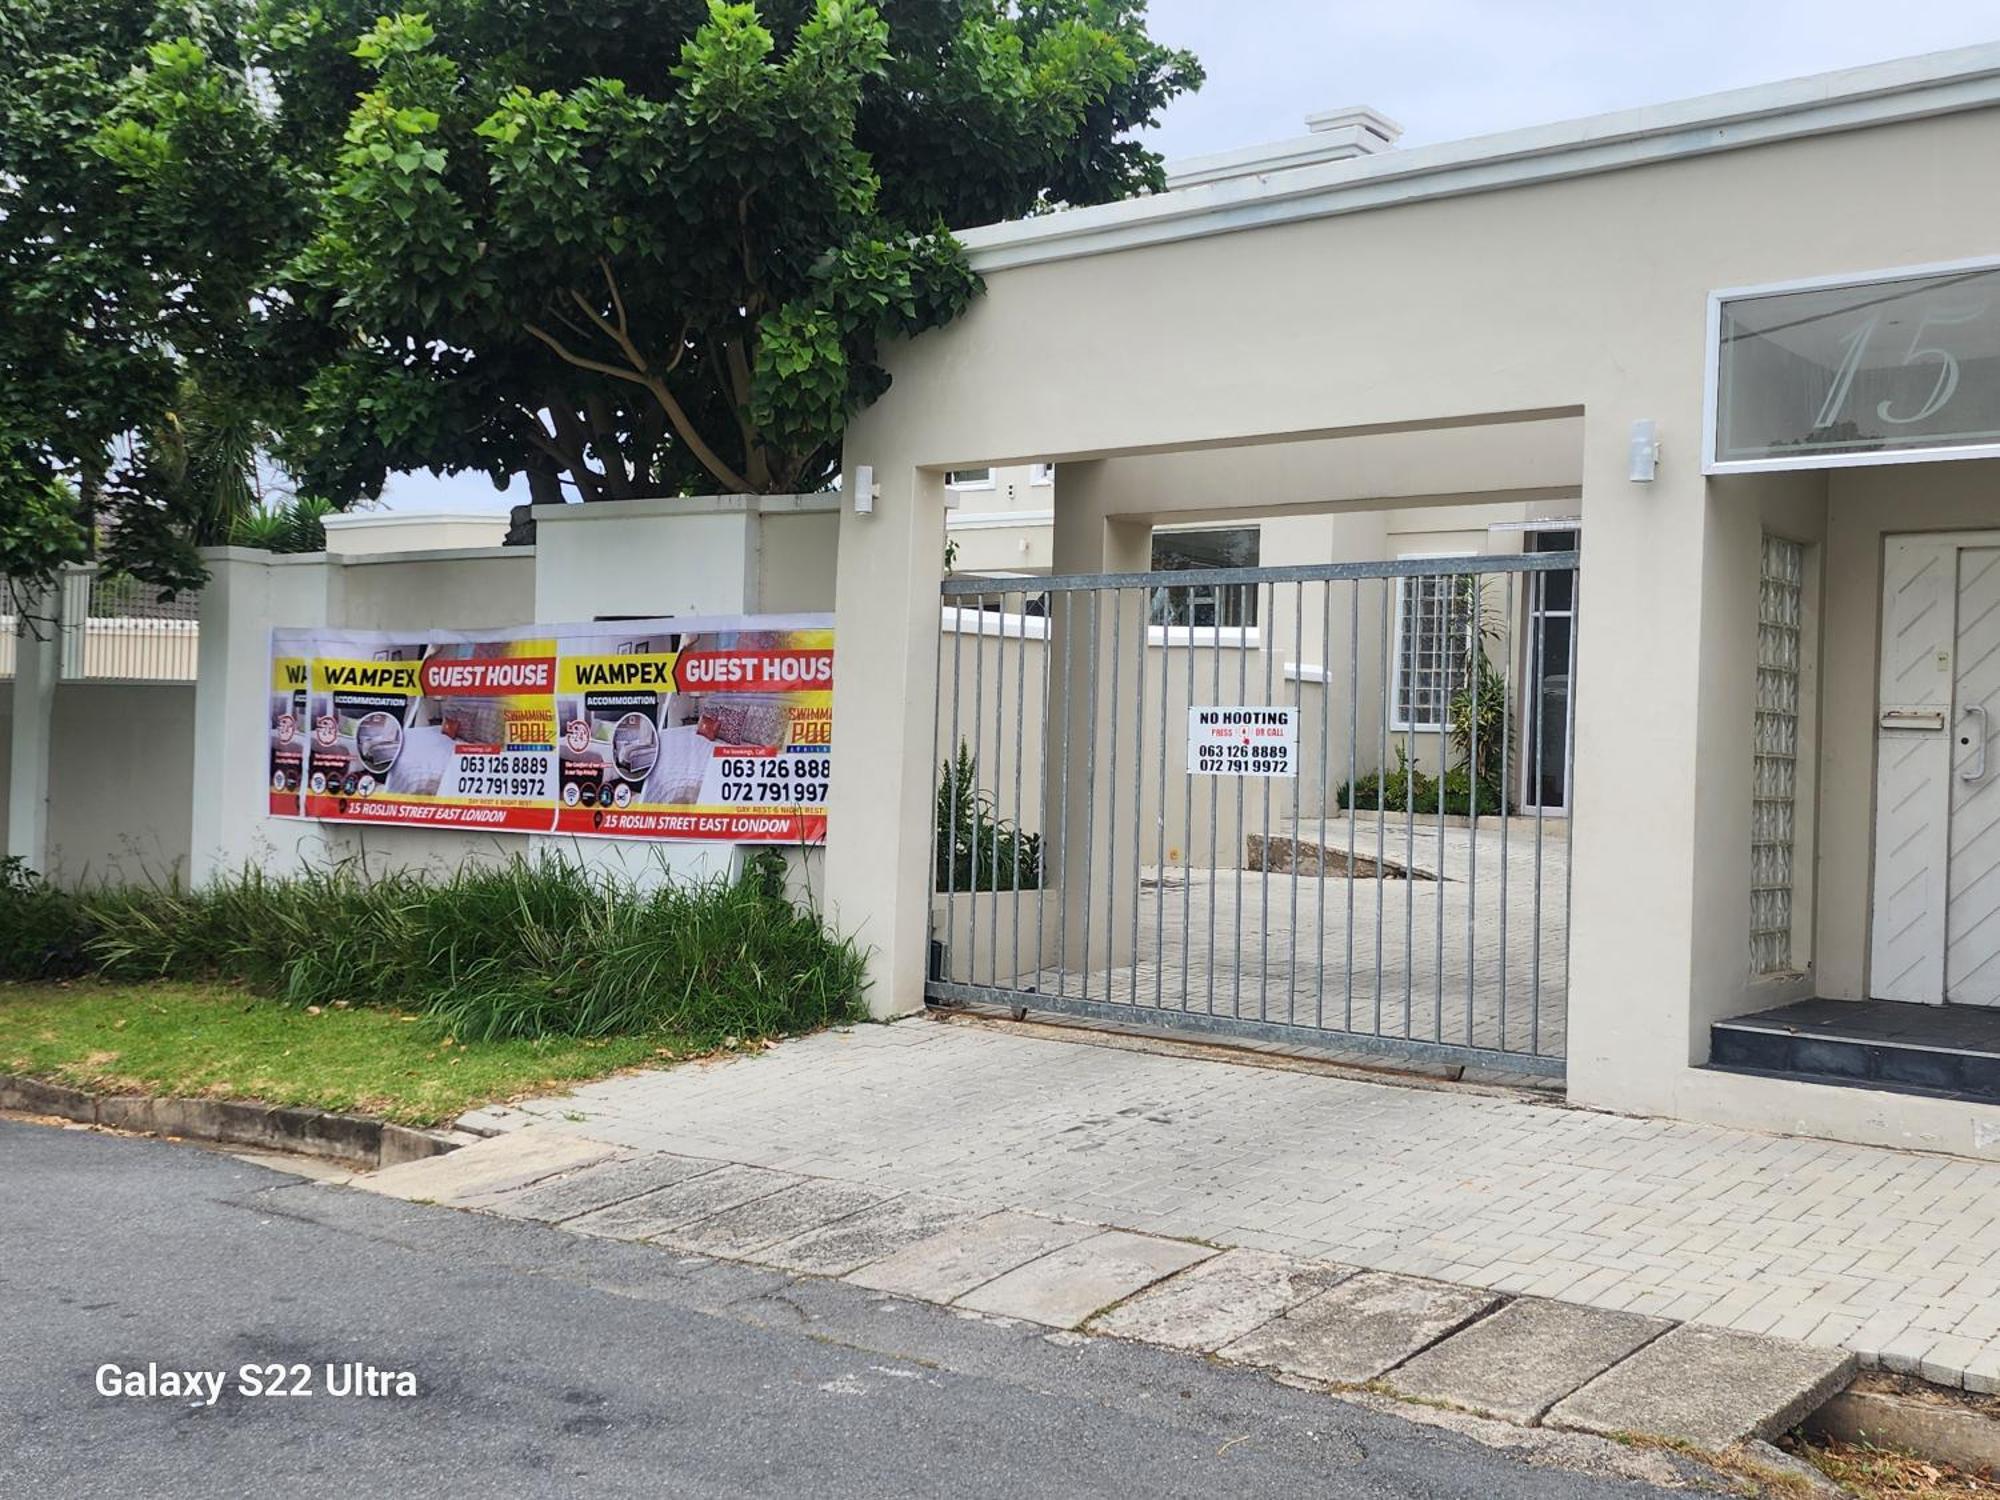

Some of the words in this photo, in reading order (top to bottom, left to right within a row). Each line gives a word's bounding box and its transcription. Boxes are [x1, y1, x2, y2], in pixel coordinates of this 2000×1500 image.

[1815, 297, 1990, 428] 15
[324, 666, 416, 688] WAMPEX
[428, 667, 484, 687] GUEST
[485, 664, 548, 686] HOUSE
[576, 662, 667, 685] WAMPEX
[686, 658, 757, 682] GUEST
[587, 695, 656, 706] ACCOMMODATION
[504, 709, 552, 721] SWIMMING
[1200, 712, 1219, 724] NO
[1223, 712, 1288, 725] HOOTING
[510, 723, 552, 743] POOL
[1212, 728, 1232, 736] PRESS
[1255, 728, 1265, 736] OR
[1267, 728, 1284, 737] CALL
[1199, 745, 1223, 757] 063
[1227, 745, 1248, 758] 126
[1251, 746, 1287, 758] 8889
[460, 756, 485, 774] 063
[488, 757, 509, 774] 126
[511, 757, 548, 775] 8889
[722, 759, 755, 778] 063
[760, 759, 789, 778] 126
[1200, 759, 1223, 771] 072
[1227, 760, 1248, 772] 791
[1252, 760, 1288, 772] 9972
[458, 777, 483, 794] 072
[486, 778, 508, 795] 791
[511, 778, 545, 796] 9972
[721, 782, 753, 801] 072
[757, 783, 789, 801] 791
[348, 802, 361, 814] 15
[362, 803, 398, 817] ROSLIN
[398, 805, 436, 819] STREET
[435, 807, 461, 820] EAST
[461, 809, 507, 823] LONDON
[604, 815, 617, 828] 15
[619, 816, 655, 829] ROSLIN
[657, 816, 697, 831] STREET
[699, 817, 729, 831] EAST
[731, 819, 790, 833] LONDON
